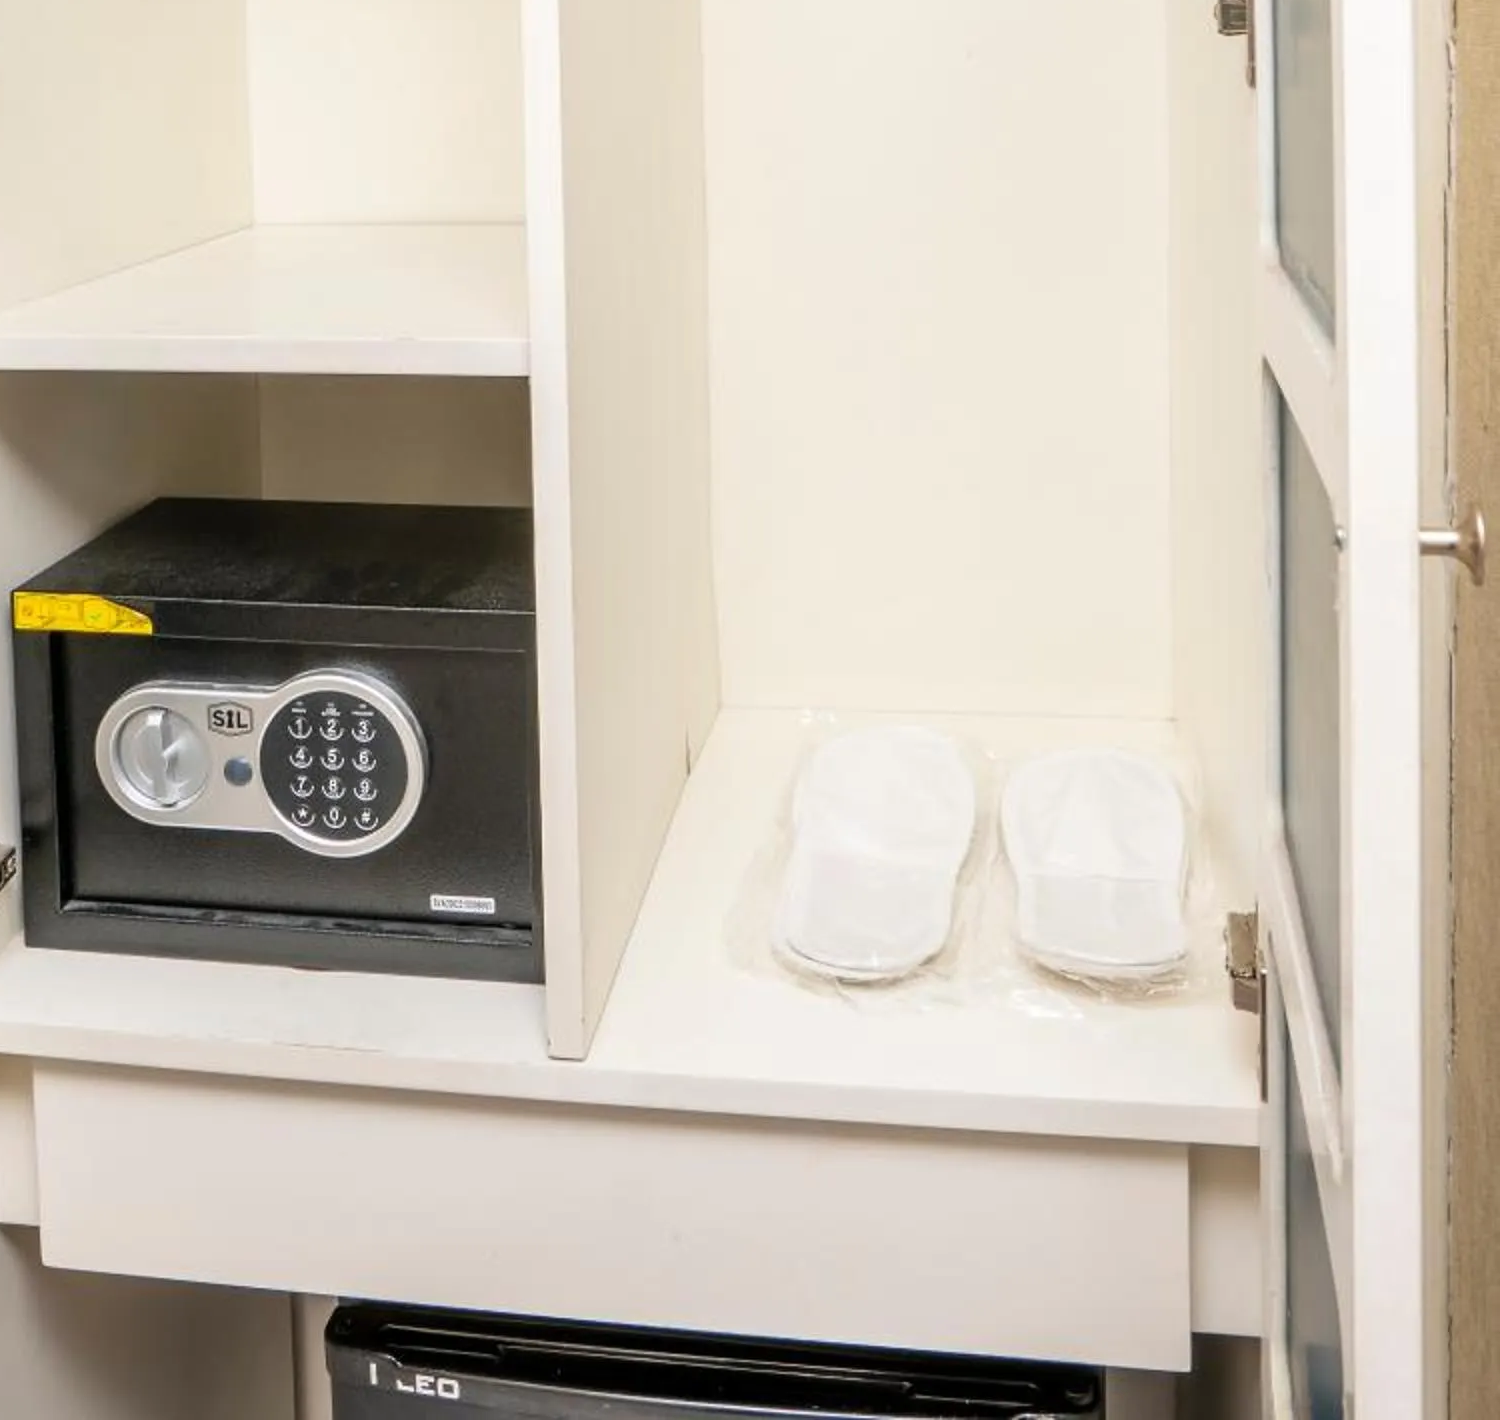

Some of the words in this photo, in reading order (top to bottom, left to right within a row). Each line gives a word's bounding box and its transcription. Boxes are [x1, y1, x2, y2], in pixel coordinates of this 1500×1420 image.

[327, 718, 337, 734] 2
[359, 720, 369, 735] 3
[327, 748, 337, 763] 5
[359, 750, 369, 765] 6
[329, 778, 338, 793] 8
[360, 779, 370, 795] 9
[329, 806, 339, 822] 0
